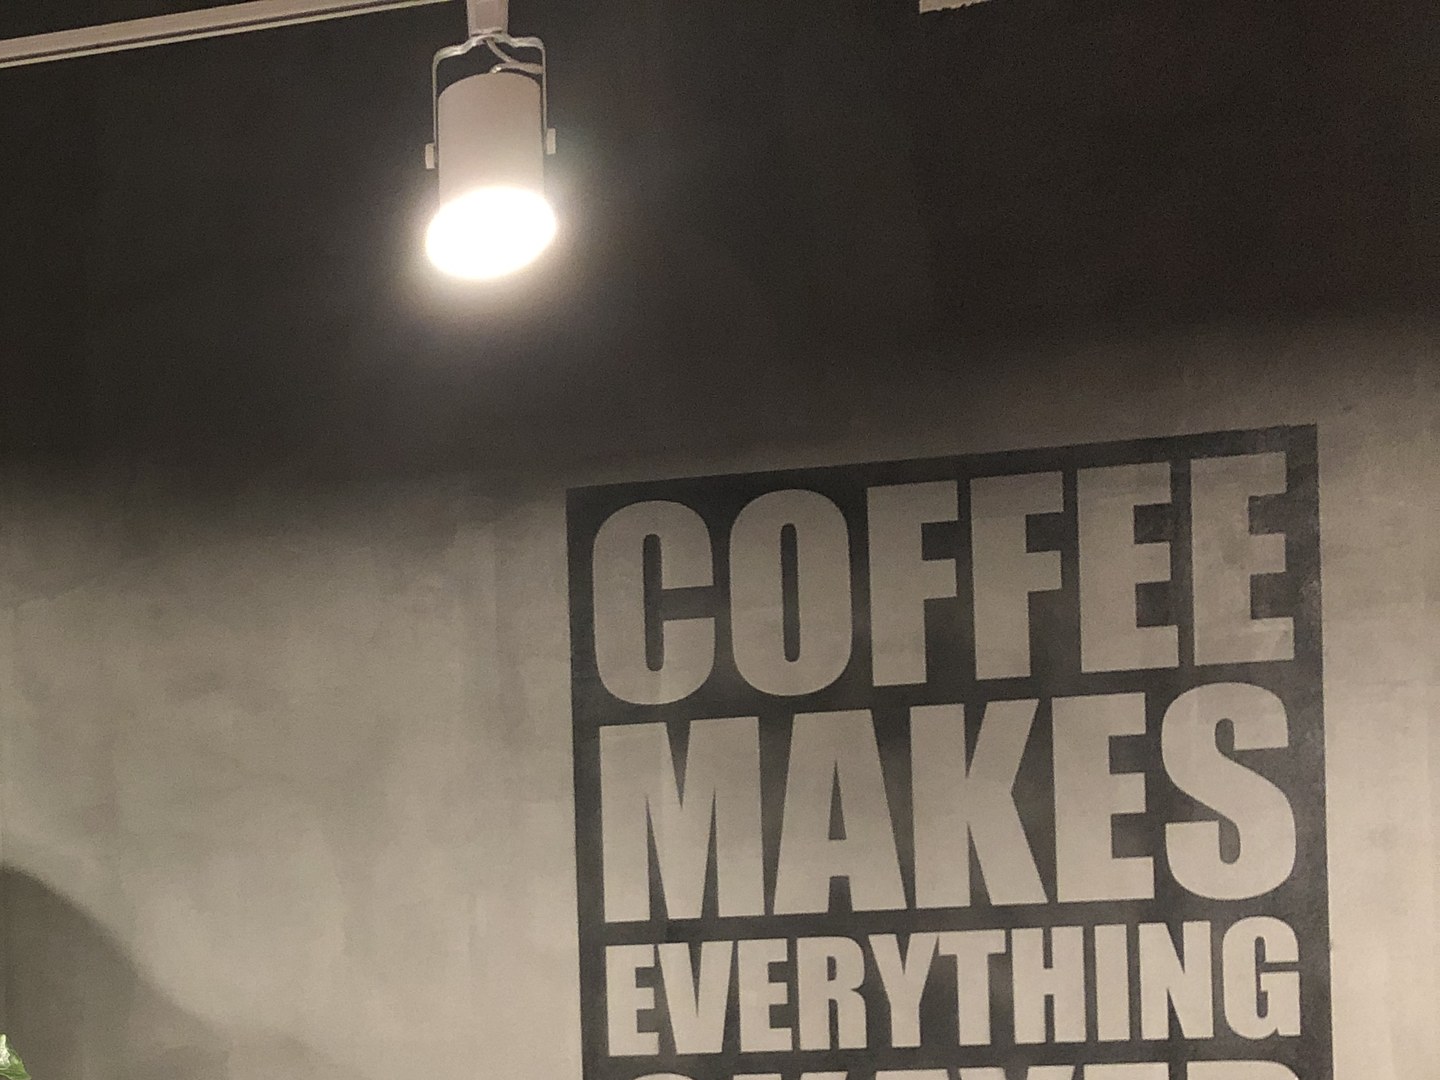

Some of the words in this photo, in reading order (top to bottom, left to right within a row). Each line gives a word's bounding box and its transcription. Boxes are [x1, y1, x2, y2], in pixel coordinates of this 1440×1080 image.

[592, 452, 1295, 706] COFFEE
[599, 682, 1297, 923] MAKES
[605, 916, 1301, 1057] EVERYTHING
